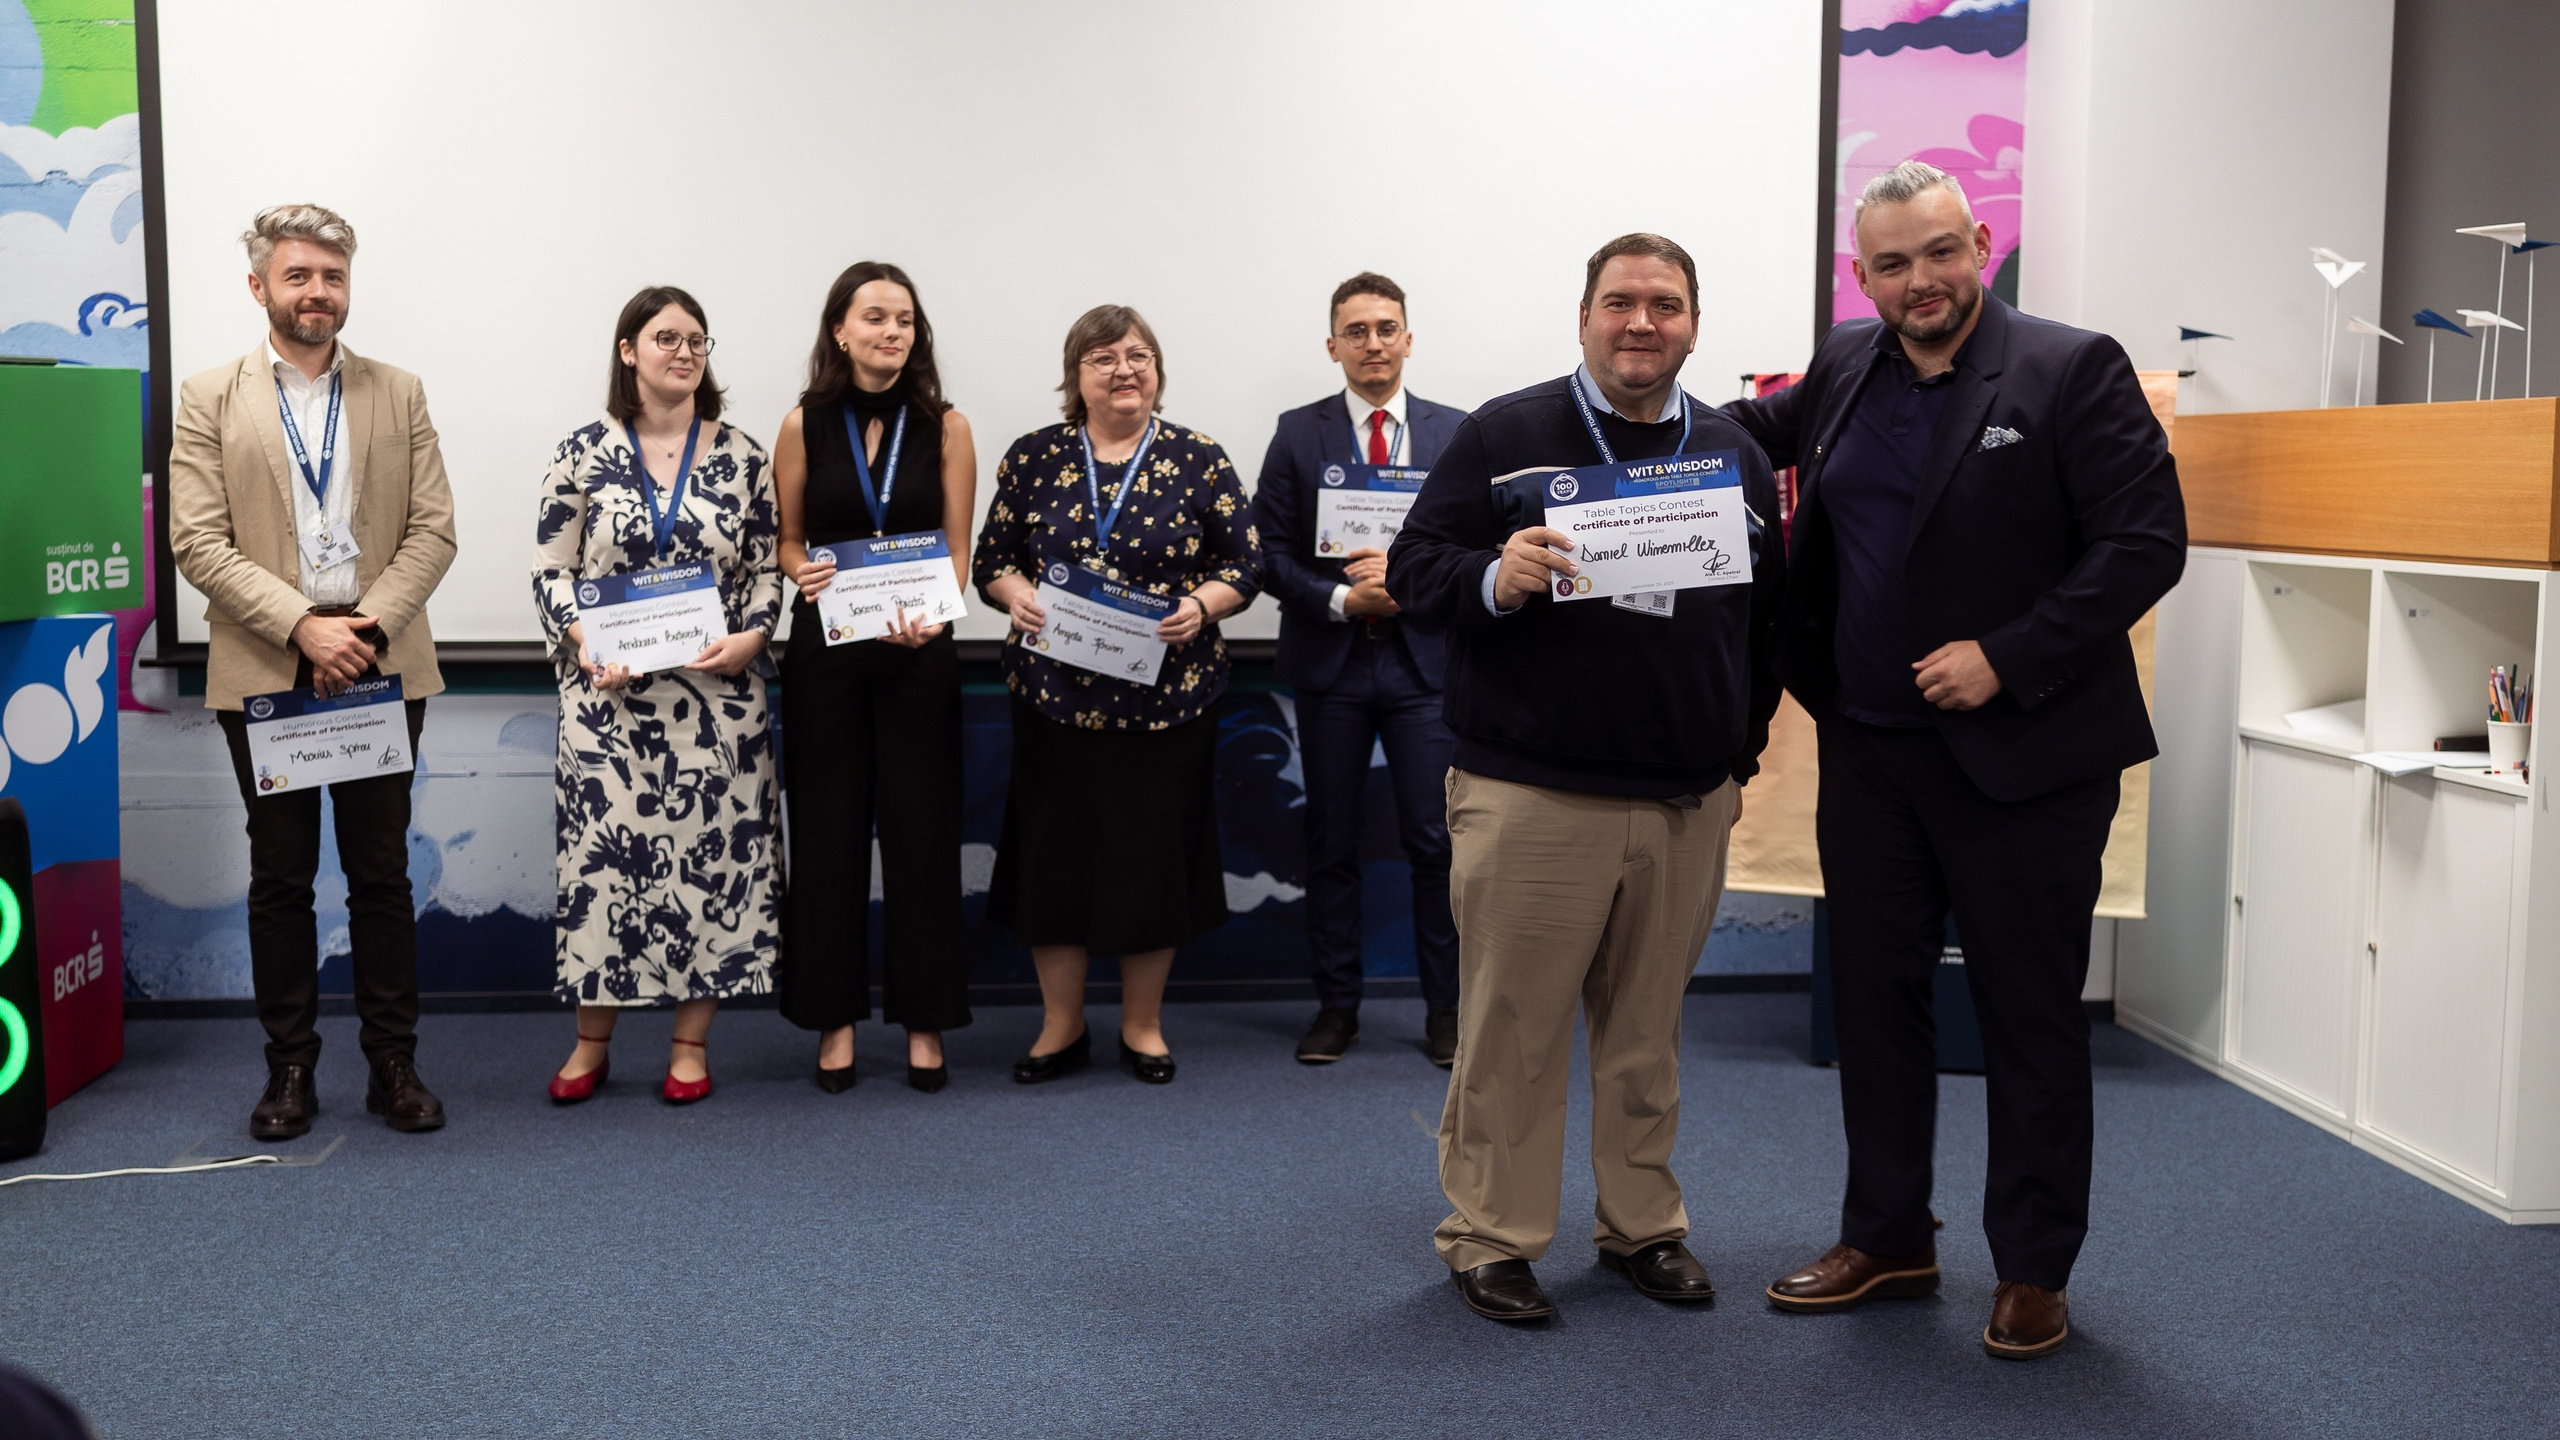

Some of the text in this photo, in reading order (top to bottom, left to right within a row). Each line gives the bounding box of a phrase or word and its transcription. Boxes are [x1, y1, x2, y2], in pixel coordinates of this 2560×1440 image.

[1574, 386, 1597, 427] TOASTMASTERS
[1627, 458, 1723, 478] WIT&WISDOM
[1555, 482, 1573, 491] 100
[1655, 478, 1693, 487] SPOTLIGHT
[1583, 498, 1705, 519] Table Topics Contest
[1573, 509, 1719, 531] Certificate of Participation
[1628, 529, 1656, 537] Presented
[82, 542, 94, 553] de
[869, 535, 937, 552] WIT&WISDOM
[1580, 543, 1628, 563] Daniel
[46, 559, 100, 595] BCR
[632, 566, 702, 586] WIT&WISDOM
[891, 566, 924, 577] Contest
[835, 583, 877, 594] Certificate
[888, 574, 937, 586] Participation
[1102, 582, 1170, 609] WIT&WISDOM
[599, 619, 640, 630] Certificate
[652, 606, 703, 620] Participation
[1052, 603, 1091, 621] Certificate
[1101, 620, 1152, 638] Participation
[270, 729, 317, 743] Certificate
[330, 718, 386, 733] Participation
[282, 711, 371, 731] Humorous Contest
[54, 953, 86, 1003] BCR
